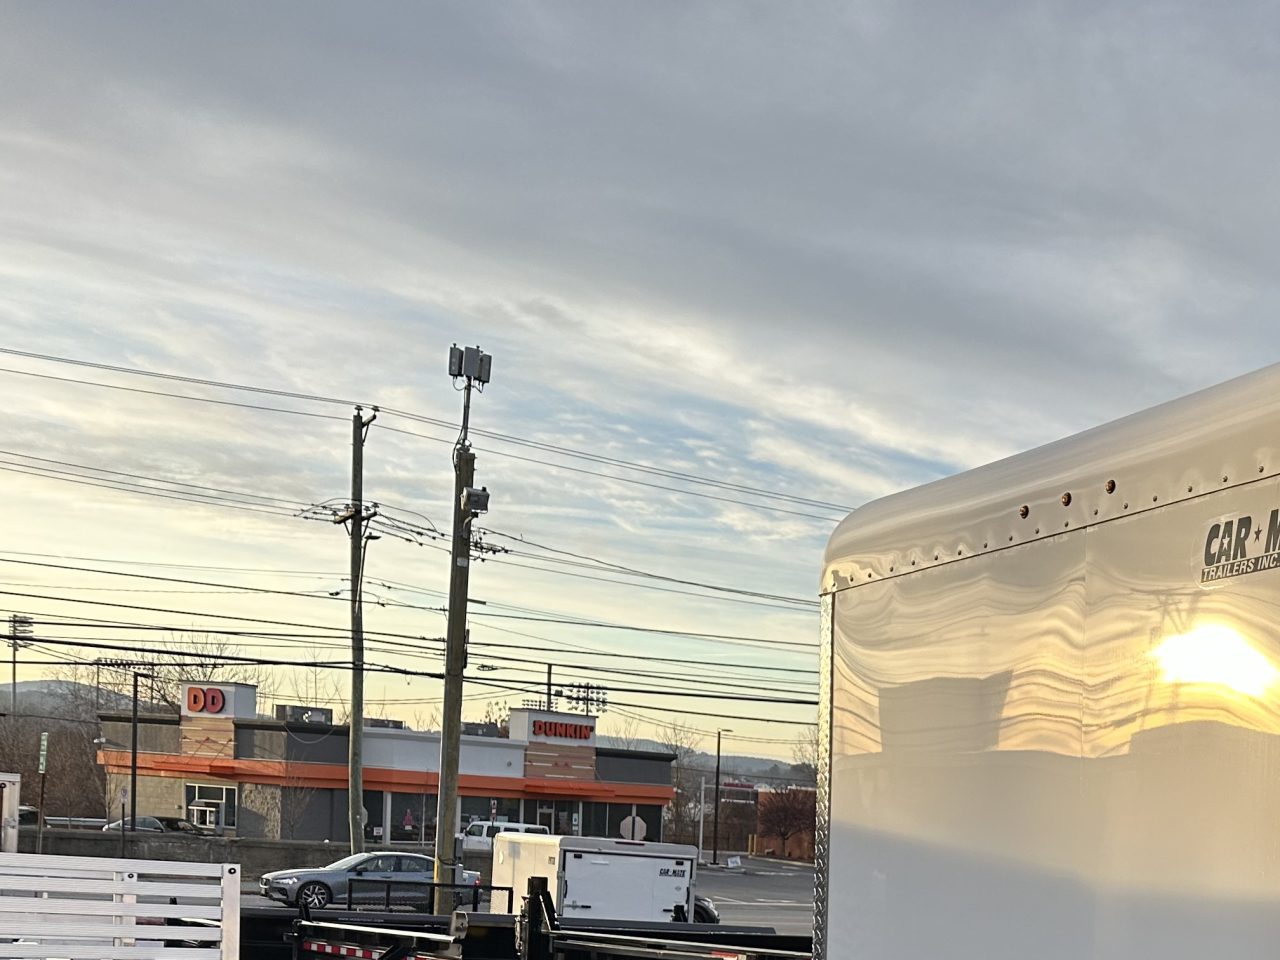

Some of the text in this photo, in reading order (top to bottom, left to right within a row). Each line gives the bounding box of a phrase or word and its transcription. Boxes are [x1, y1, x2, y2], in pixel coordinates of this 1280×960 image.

[1204, 516, 1252, 567] CAR
[1202, 553, 1280, 581] TRAILERS INC.
[187, 687, 225, 713] DD
